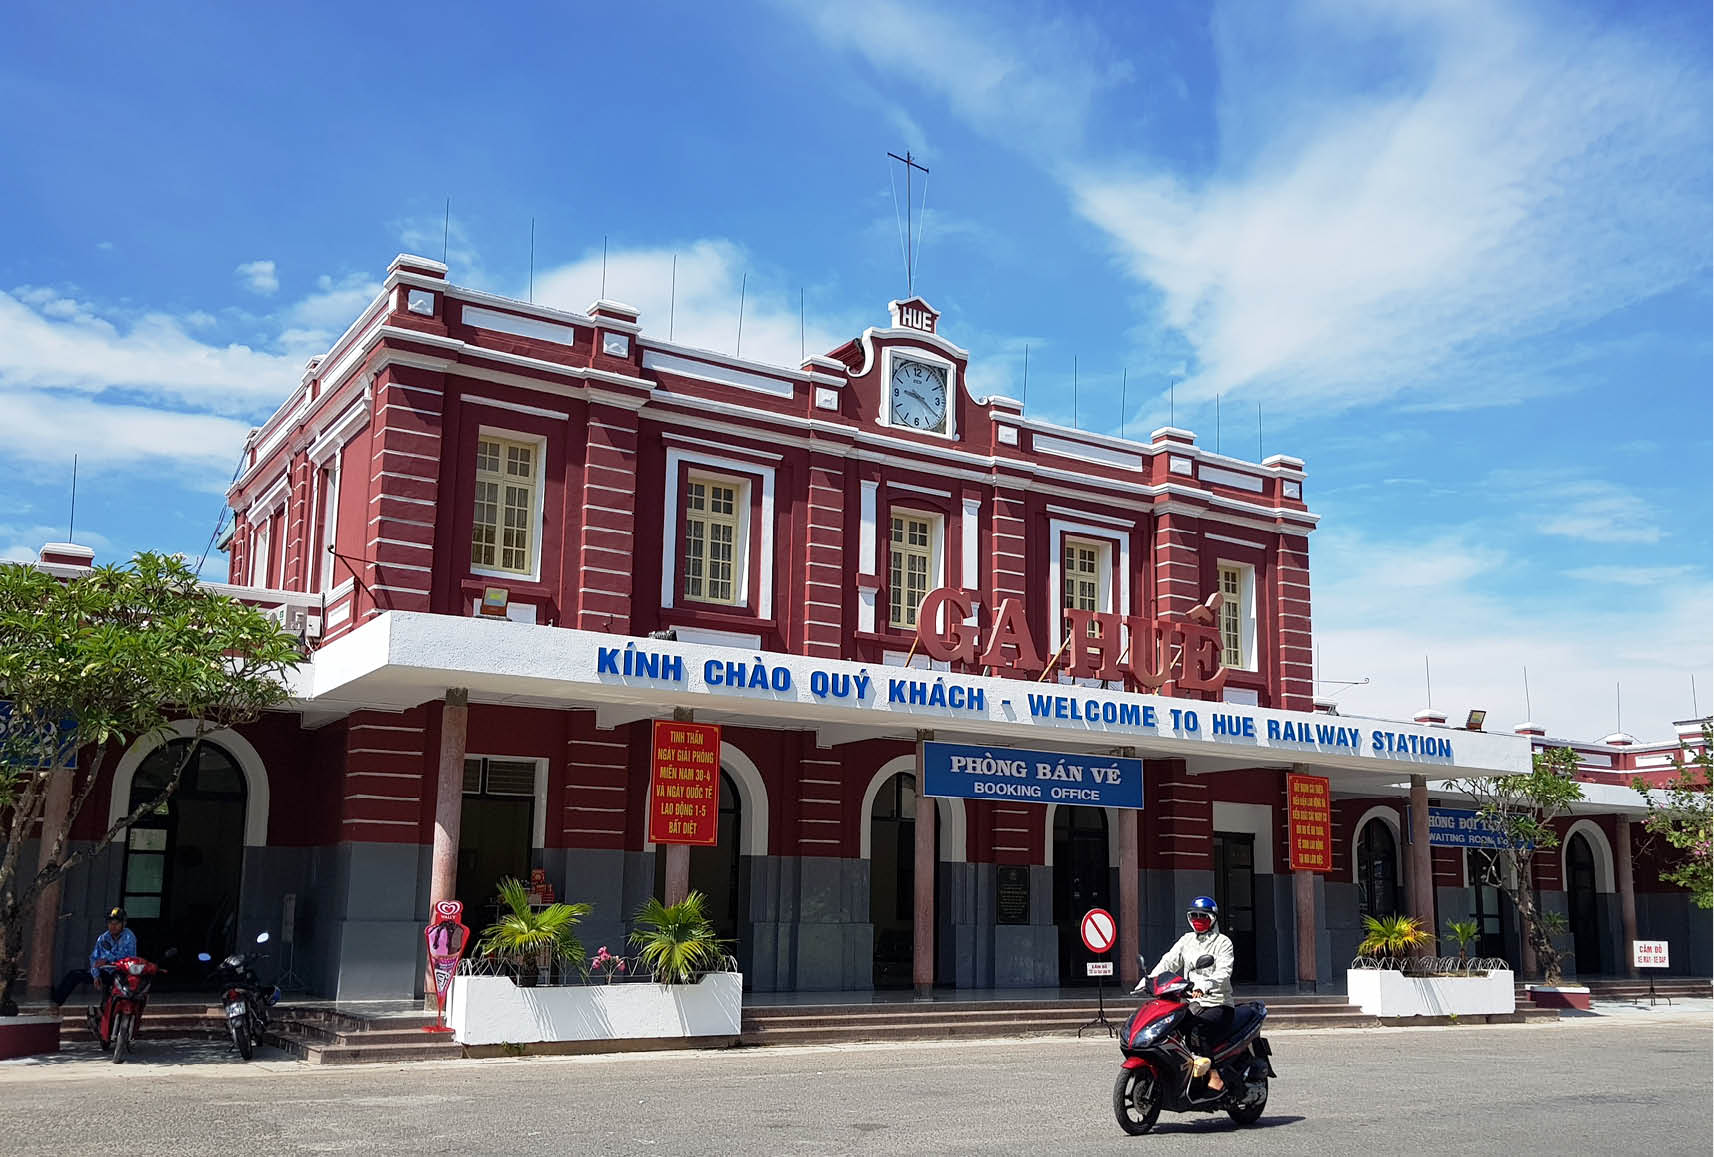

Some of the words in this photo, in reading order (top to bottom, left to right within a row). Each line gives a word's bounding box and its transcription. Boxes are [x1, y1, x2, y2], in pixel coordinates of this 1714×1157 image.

[902, 307, 932, 332] HUE
[914, 368, 922, 378] 12
[894, 388, 900, 397] 9
[935, 397, 940, 406] 3
[914, 417, 920, 426] 6
[917, 587, 1045, 672] GA
[1064, 591, 1230, 690] HUẾ
[597, 641, 682, 681] KÍNH
[704, 656, 791, 691] CHÀO
[810, 668, 870, 700] QUÝ
[889, 677, 984, 711] KHÁCH
[1027, 693, 1156, 728] WELCOME
[1169, 708, 1198, 732] TO
[1212, 713, 1255, 737] HUE
[1267, 719, 1359, 748] RAILWAY
[1372, 731, 1451, 758] STATION
[679, 767, 694, 781] NAM
[950, 752, 1028, 778] PHÒNG
[1036, 759, 1084, 782] BÁN
[1090, 763, 1122, 785] VÉ
[974, 782, 1041, 798] BOOKING
[1050, 787, 1100, 800] OFFICE
[661, 802, 674, 815] LAO
[695, 805, 706, 817] 1-5
[1429, 811, 1455, 829] HÒNG
[1428, 832, 1465, 843] WAITING
